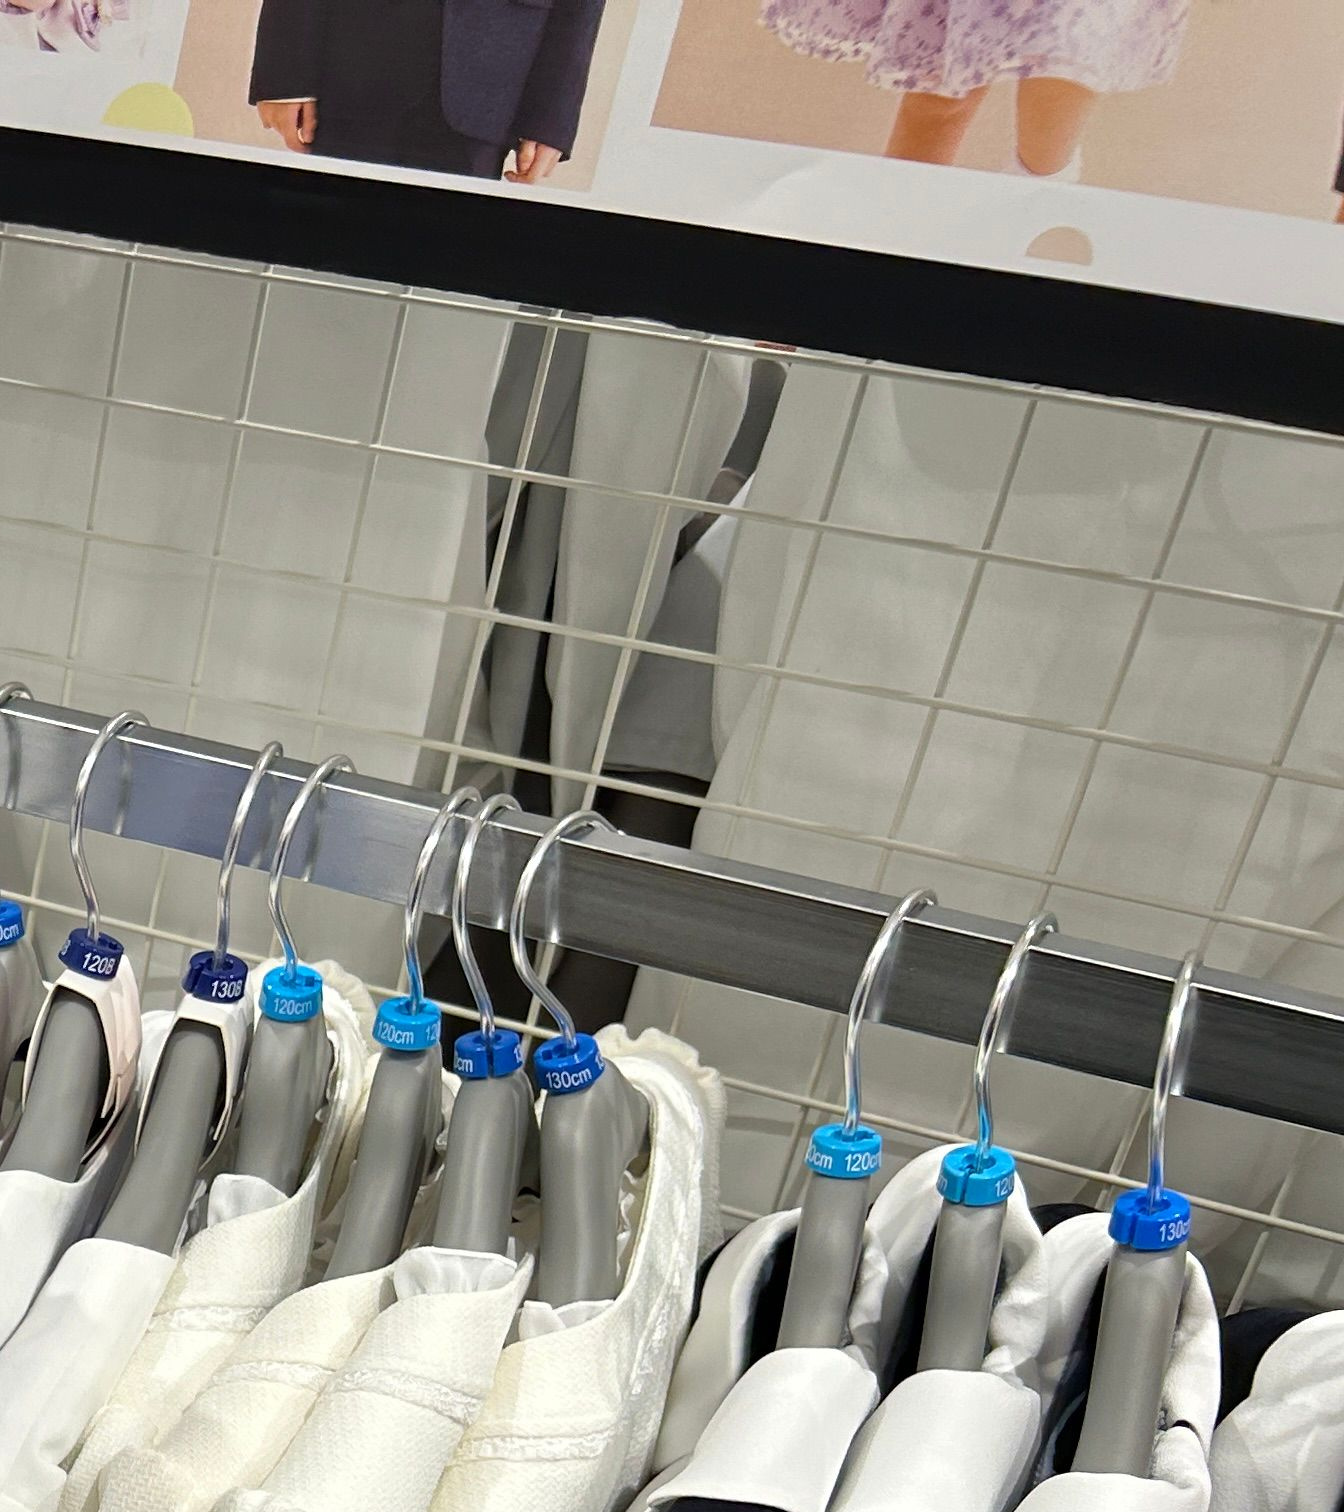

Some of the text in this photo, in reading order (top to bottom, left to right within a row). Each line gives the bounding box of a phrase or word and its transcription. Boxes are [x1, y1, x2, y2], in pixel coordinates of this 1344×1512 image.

[82, 952, 116, 976] 120B
[211, 979, 244, 998] 130B
[273, 998, 313, 1016] 120cm
[377, 1021, 415, 1045] 120cm
[545, 1068, 593, 1089] 130cm
